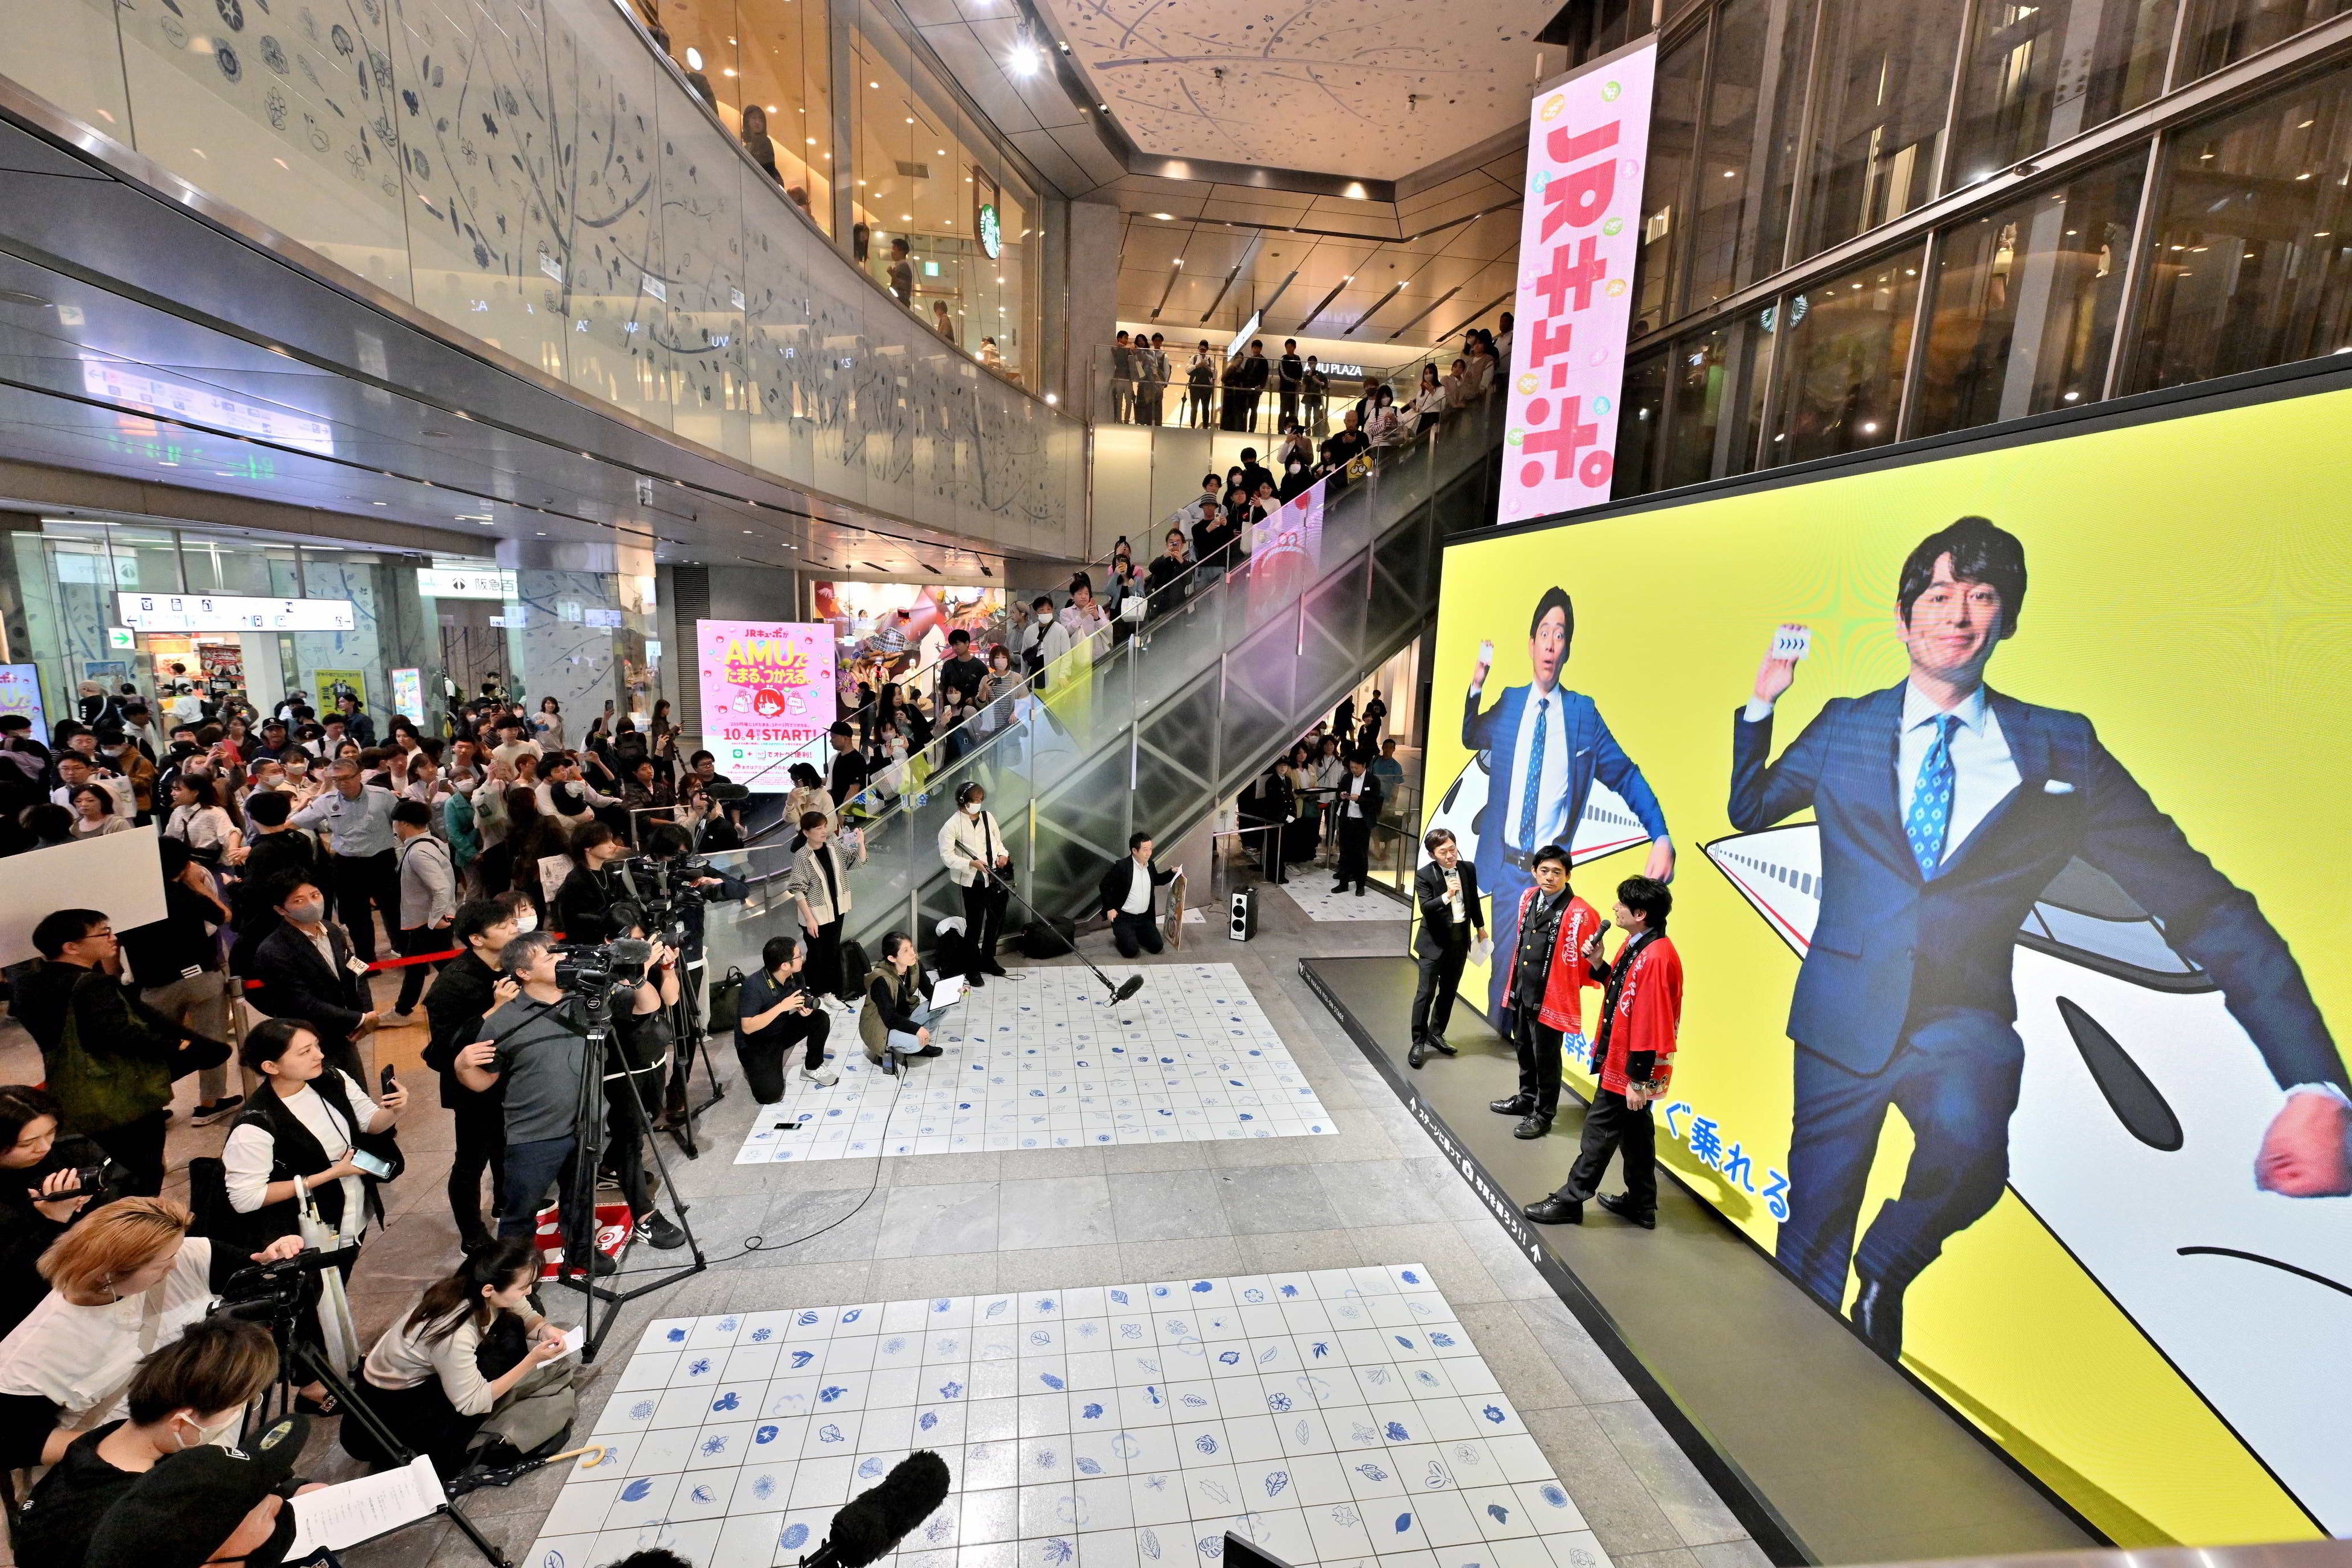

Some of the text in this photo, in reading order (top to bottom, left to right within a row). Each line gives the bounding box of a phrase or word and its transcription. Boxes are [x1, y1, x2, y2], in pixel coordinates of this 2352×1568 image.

[1330, 364, 1362, 377] PLAZA
[745, 627, 789, 639] JRキューポが
[723, 639, 810, 668] AMUで
[724, 668, 813, 684] たまる、つかえる。
[762, 729, 817, 741] START!
[1333, 1006, 1344, 1022] STAGE
[1664, 1101, 1791, 1219] ぐ乗れる
